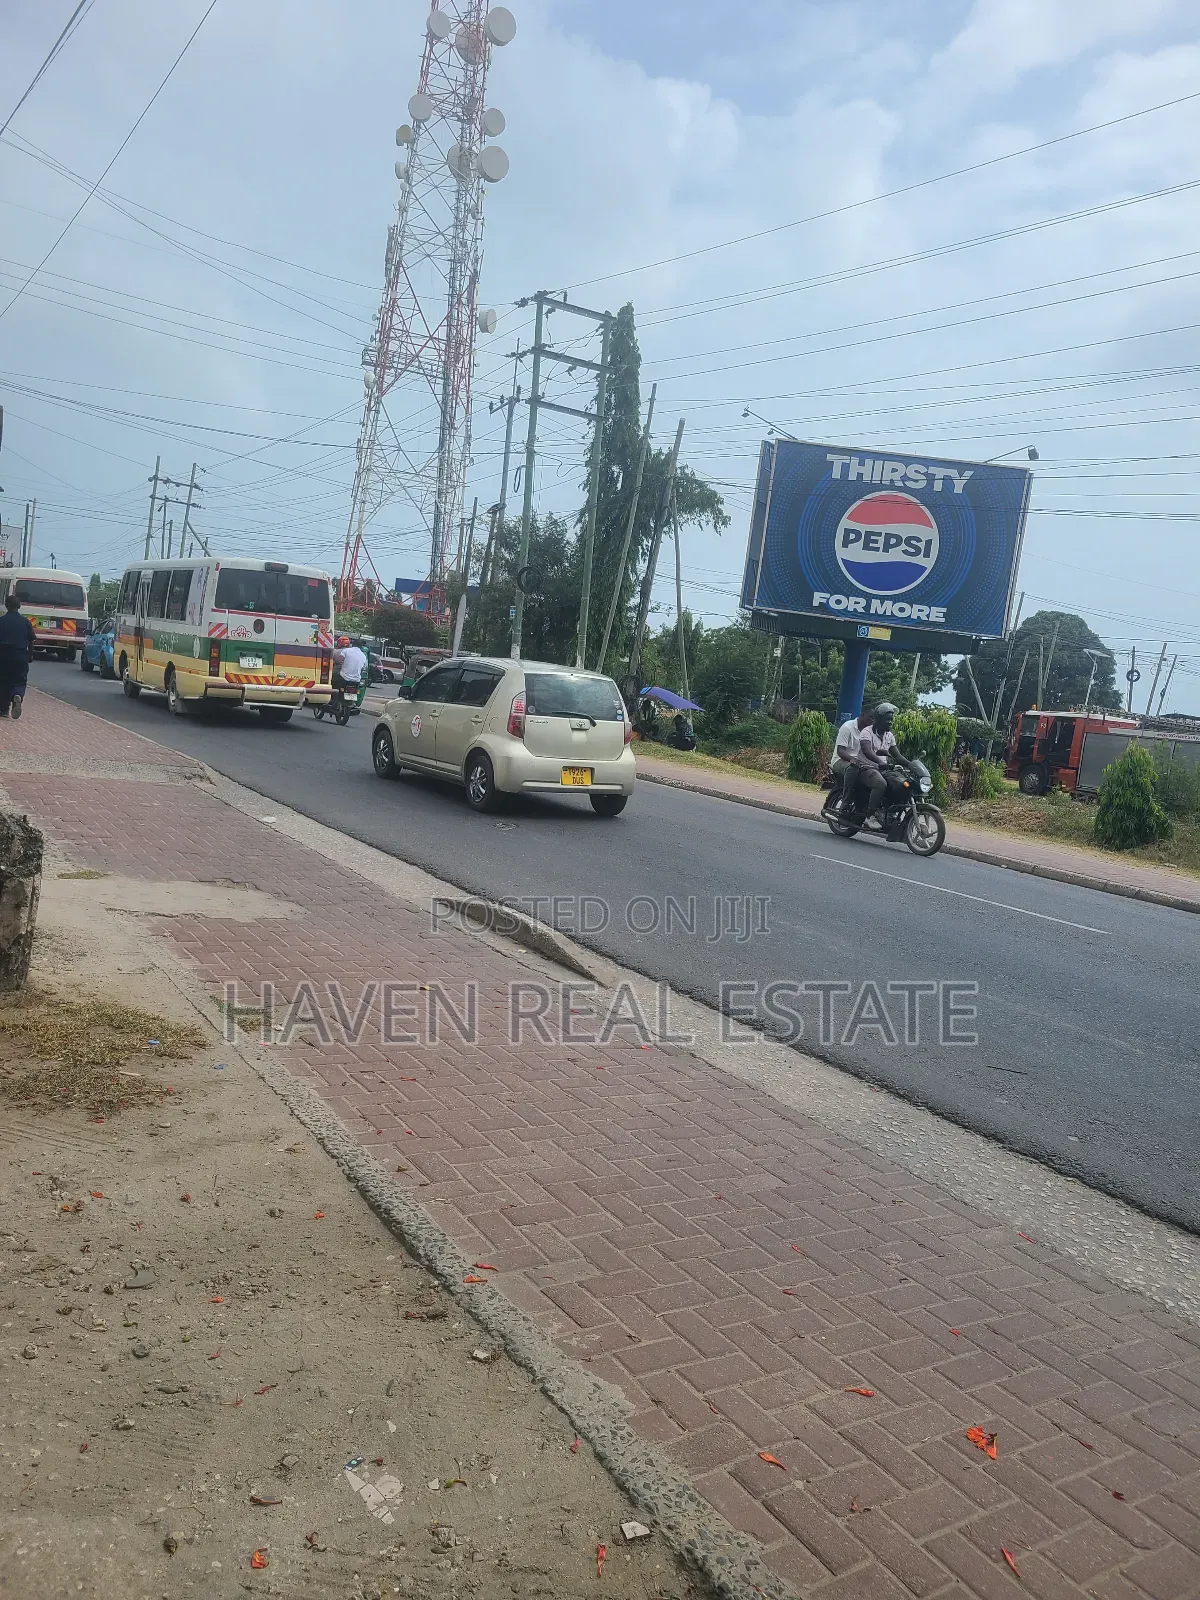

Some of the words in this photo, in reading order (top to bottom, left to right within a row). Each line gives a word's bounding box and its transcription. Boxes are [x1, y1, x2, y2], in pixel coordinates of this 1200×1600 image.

[827, 454, 975, 494] THIRSTY
[841, 527, 933, 559] PEPSI
[812, 592, 867, 614] FOR
[870, 600, 948, 623] MORE
[568, 768, 584, 776] T926
[572, 777, 585, 785] DUS
